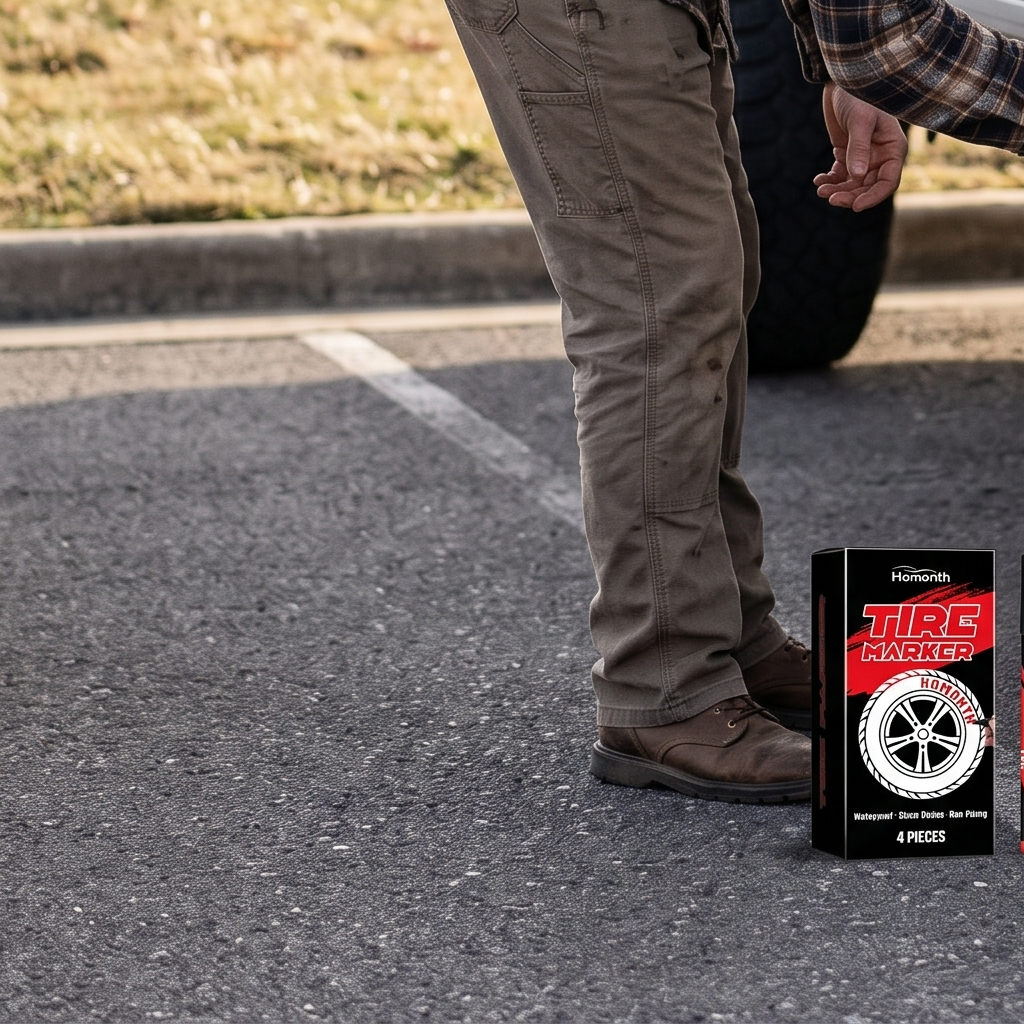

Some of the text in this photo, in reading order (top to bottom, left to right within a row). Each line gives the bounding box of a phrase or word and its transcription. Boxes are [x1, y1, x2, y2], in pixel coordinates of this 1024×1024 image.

[891, 571, 950, 582] Homonth
[862, 603, 981, 638] TIRE
[861, 641, 974, 662] MARKER
[949, 810, 964, 819] Ran
[896, 830, 946, 844] 4 PIECES
